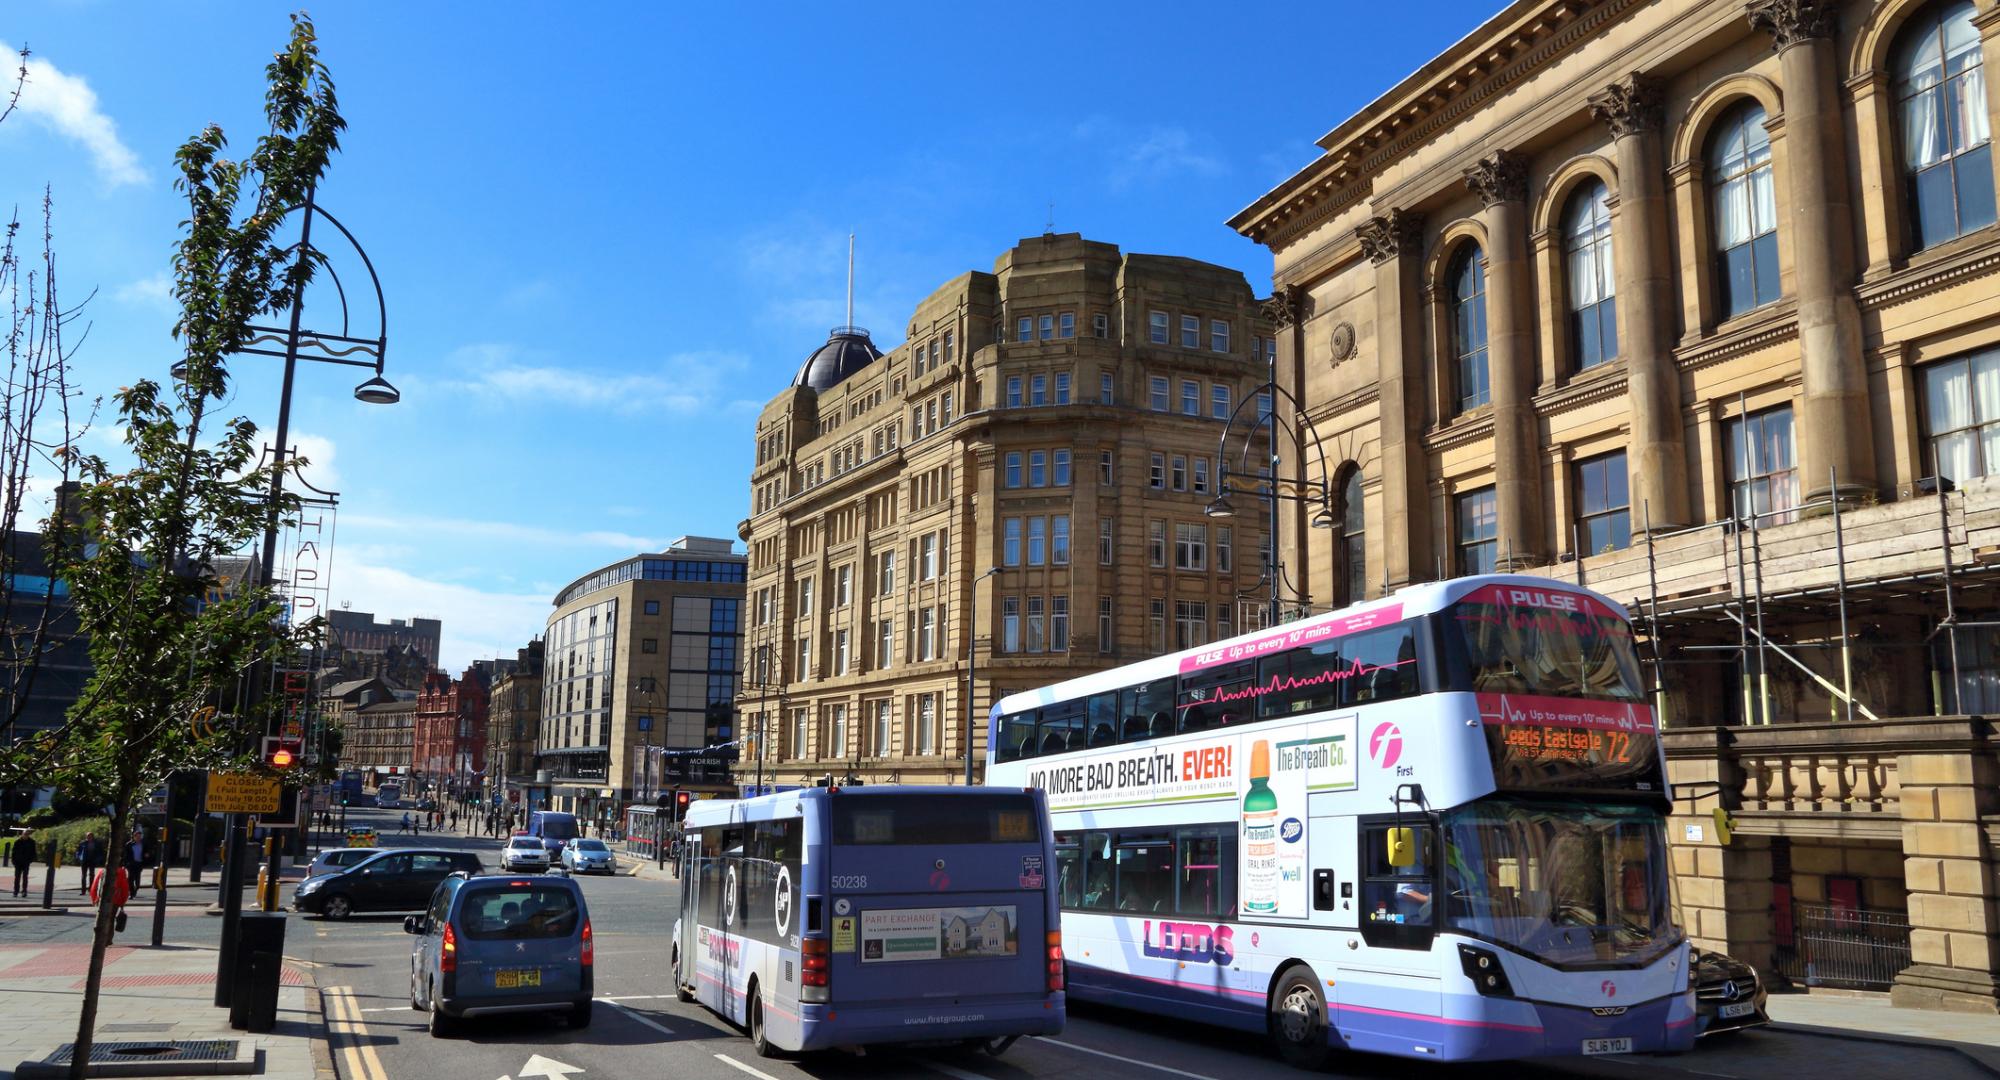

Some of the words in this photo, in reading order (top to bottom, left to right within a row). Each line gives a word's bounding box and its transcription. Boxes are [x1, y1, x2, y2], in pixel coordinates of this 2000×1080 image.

[1509, 590, 1578, 611] PULSE
[1195, 649, 1224, 666] PULSE
[1229, 645, 1243, 659] Up
[1245, 642, 1255, 654] to
[1258, 636, 1285, 653] every
[1305, 624, 1332, 641] mins
[1529, 708, 1544, 721] Up
[1545, 711, 1556, 721] to
[1558, 713, 1582, 725] every
[1595, 715, 1615, 725] mins
[1502, 724, 1541, 747] Leeds
[1544, 726, 1602, 751] Eastgate
[1606, 731, 1631, 763] 72
[1277, 746, 1293, 771] The
[1294, 744, 1328, 770] Breath
[1030, 769, 1046, 789] NO
[1049, 765, 1084, 795] MORE
[1086, 761, 1114, 791] BAD
[1118, 753, 1178, 789] BREATH.
[1182, 744, 1233, 782] EVER!
[1396, 766, 1413, 777] First
[226, 778, 265, 786] CLOSED
[1282, 866, 1301, 881] well
[831, 875, 868, 889] 50238
[865, 914, 888, 924] PART
[904, 1014, 985, 1025] www.firstgroup.com
[1588, 1039, 1608, 1052] SL16
